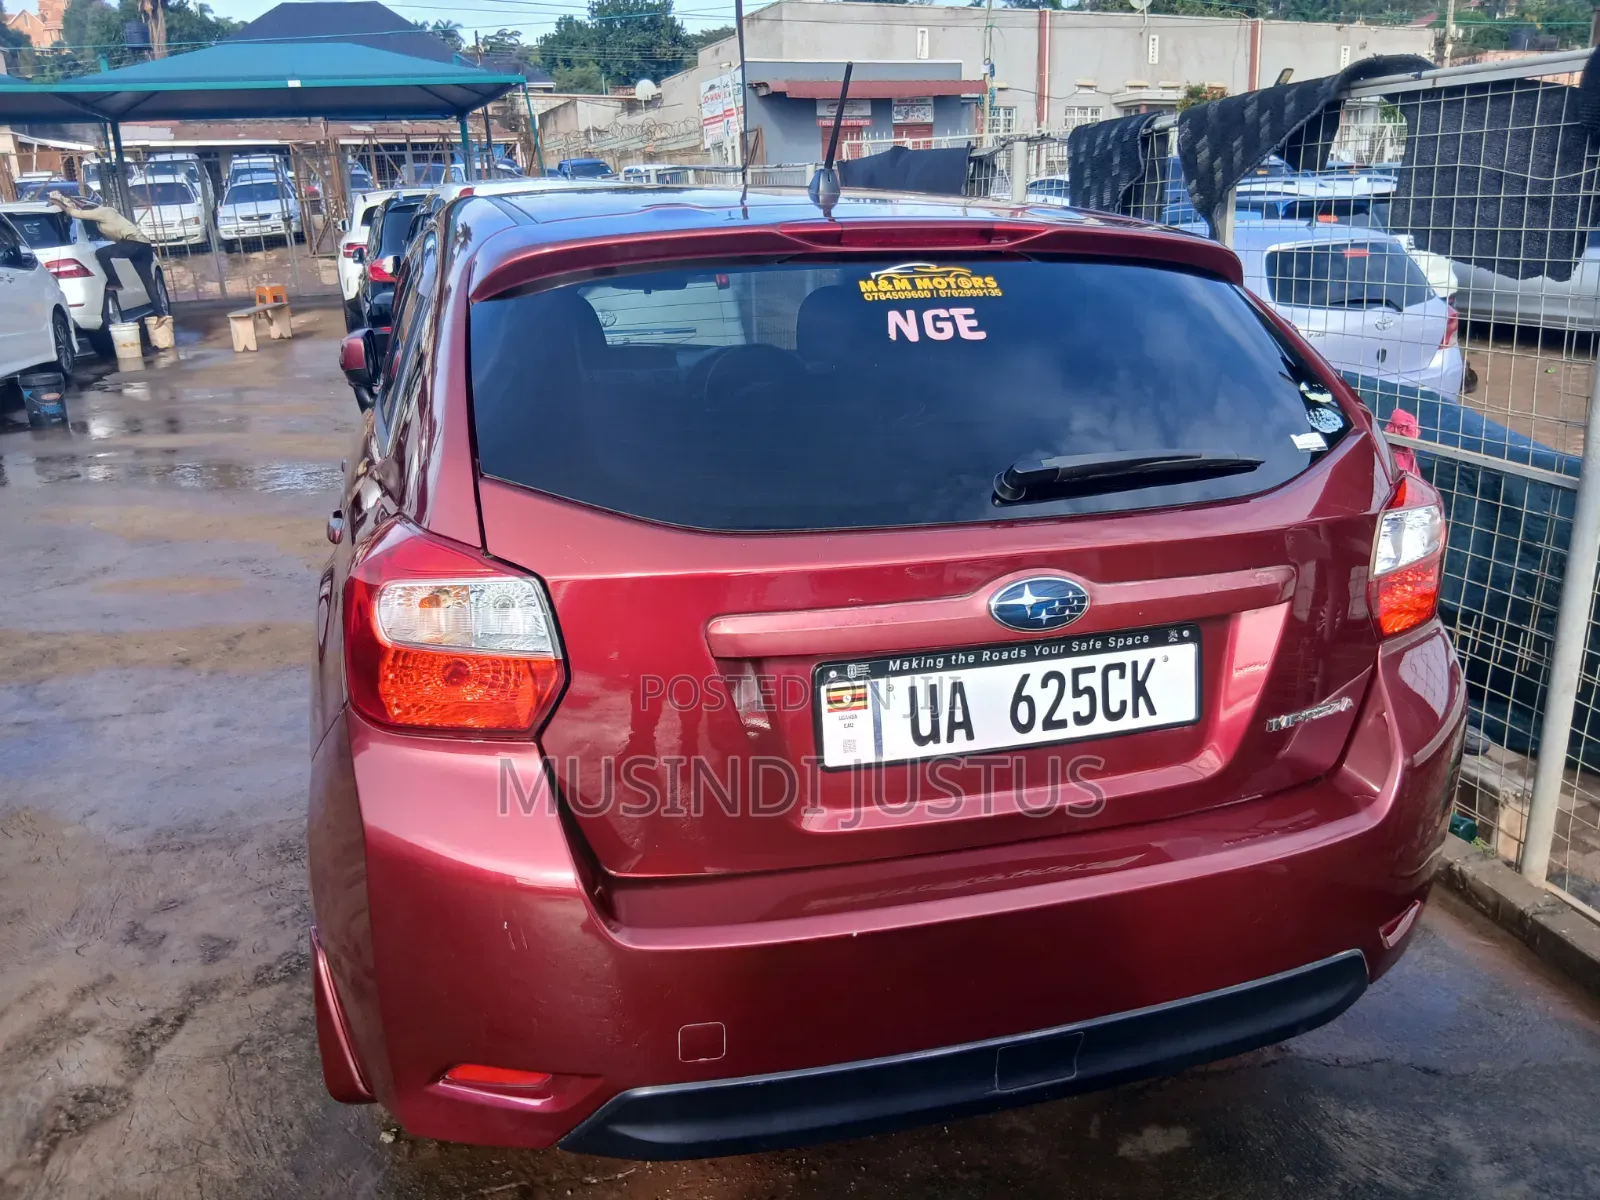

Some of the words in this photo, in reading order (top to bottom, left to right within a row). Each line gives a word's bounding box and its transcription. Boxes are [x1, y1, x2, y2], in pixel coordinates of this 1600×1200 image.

[859, 278, 912, 292] M&M
[915, 277, 998, 290] MOTORS
[863, 290, 931, 301] 0784509600
[939, 288, 1002, 297] 0702999135
[888, 307, 987, 342] NGE
[888, 657, 944, 671] Making
[951, 653, 975, 664] the
[982, 648, 1027, 661] Roads
[1034, 643, 1066, 656] Your
[1071, 638, 1102, 651] Safe
[1108, 634, 1150, 648] Space
[908, 680, 974, 747] UA
[1010, 657, 1158, 735] 625CK
